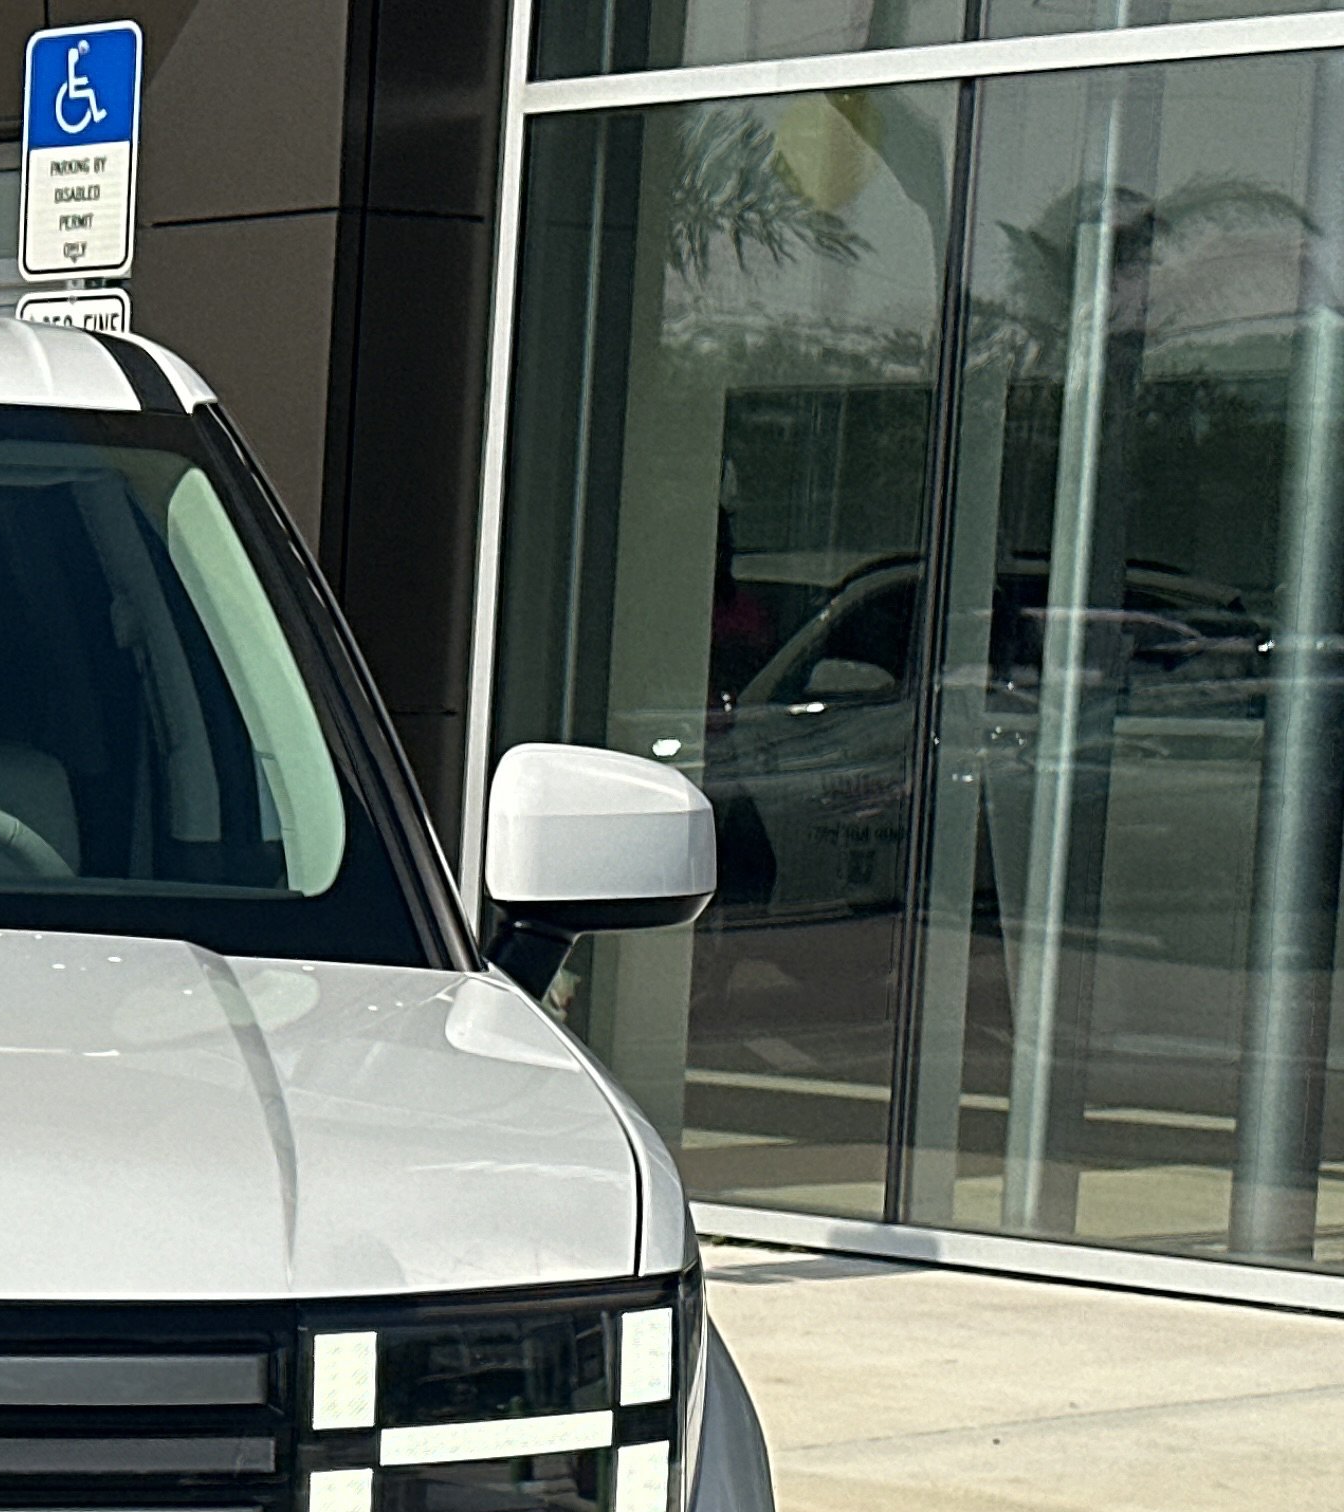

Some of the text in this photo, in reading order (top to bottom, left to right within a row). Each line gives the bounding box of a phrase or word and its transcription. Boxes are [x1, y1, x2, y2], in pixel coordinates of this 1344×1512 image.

[50, 156, 107, 176] PARKING BY
[54, 184, 100, 204] DISABLED
[59, 212, 94, 231] PERMIT
